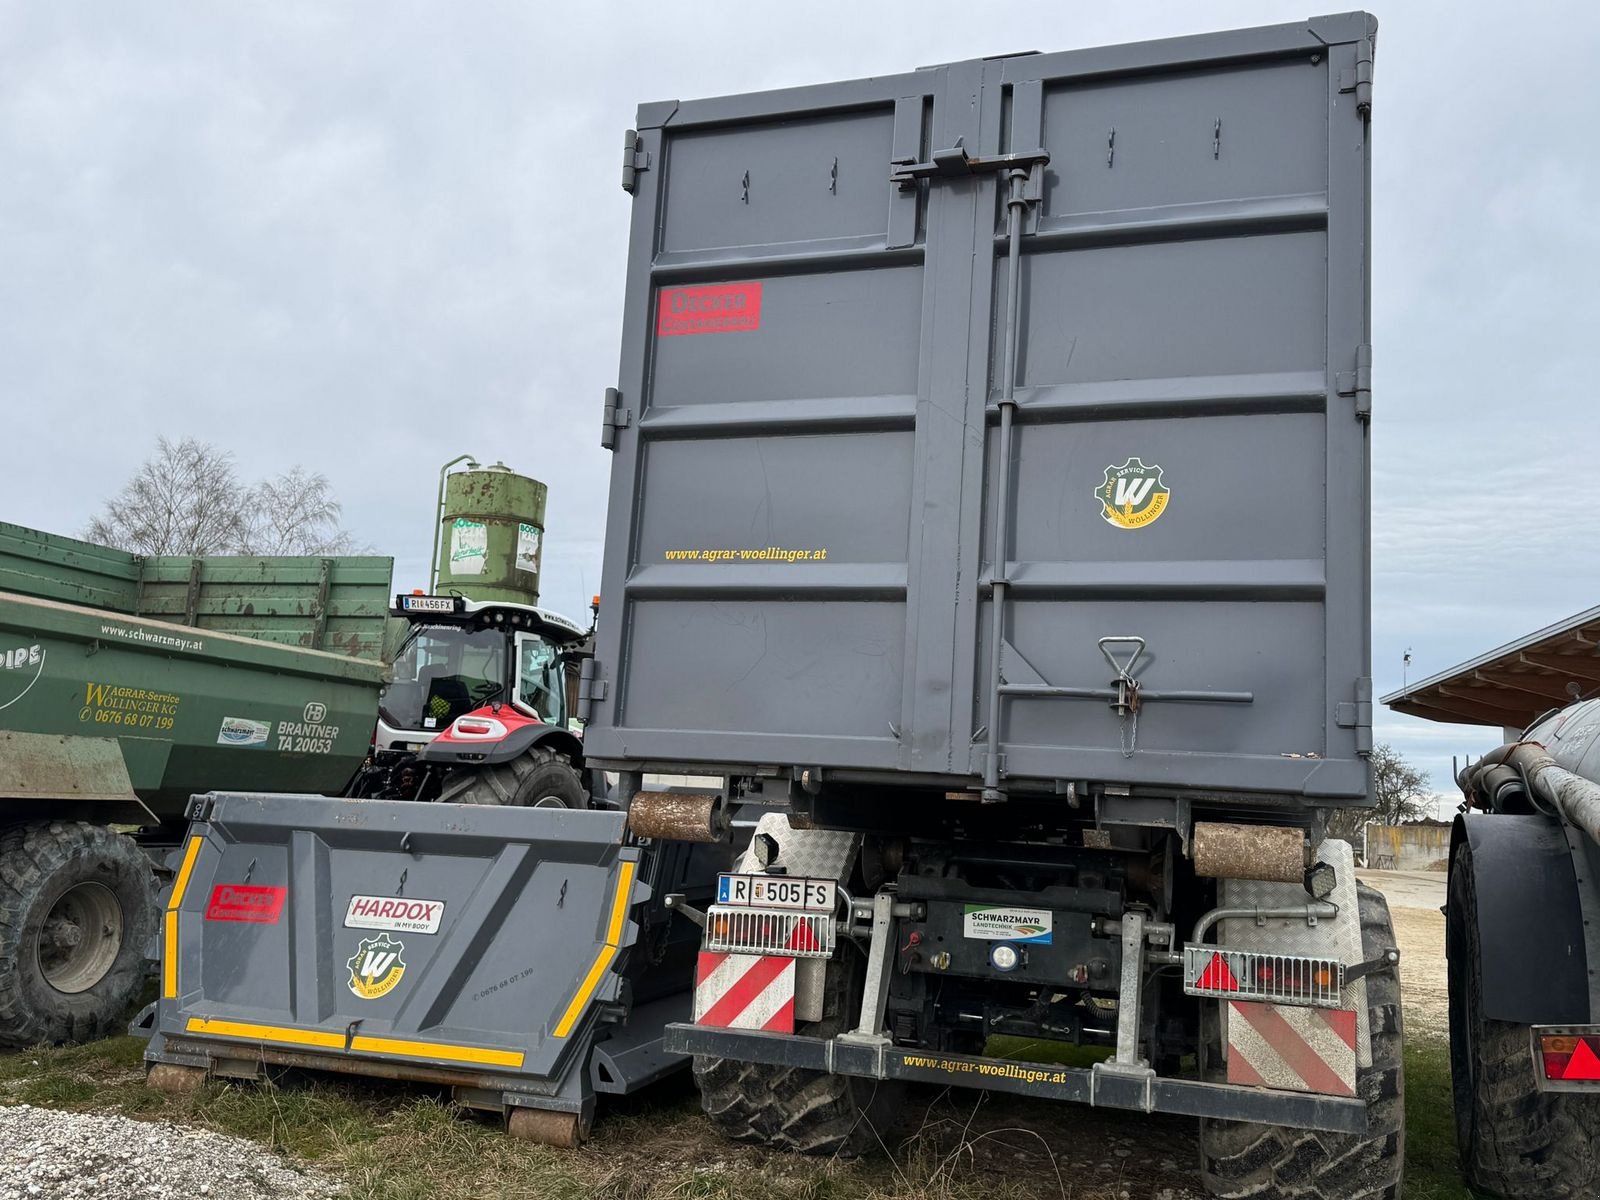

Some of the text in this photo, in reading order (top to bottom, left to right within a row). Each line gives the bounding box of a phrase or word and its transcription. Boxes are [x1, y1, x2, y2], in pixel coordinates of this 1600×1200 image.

[1116, 467, 1146, 477] SERVICE
[665, 547, 827, 563] www.agrar-woellinger.at
[101, 624, 203, 651] www.schwarzmayr.at
[111, 687, 180, 704] AGRAR-Service
[161, 704, 178, 715] KG
[95, 709, 174, 730] 0676 68 07 199
[277, 721, 339, 739] BRANTNER
[277, 736, 332, 754] TA 20053
[767, 882, 801, 903] 505
[805, 884, 827, 905] FS
[352, 898, 437, 921] HARDOX
[971, 912, 1041, 925] SCHWARZMAYR
[972, 922, 1012, 930] LANDTECHNIK
[903, 1055, 1067, 1084] www.agrar-woellinger.at
